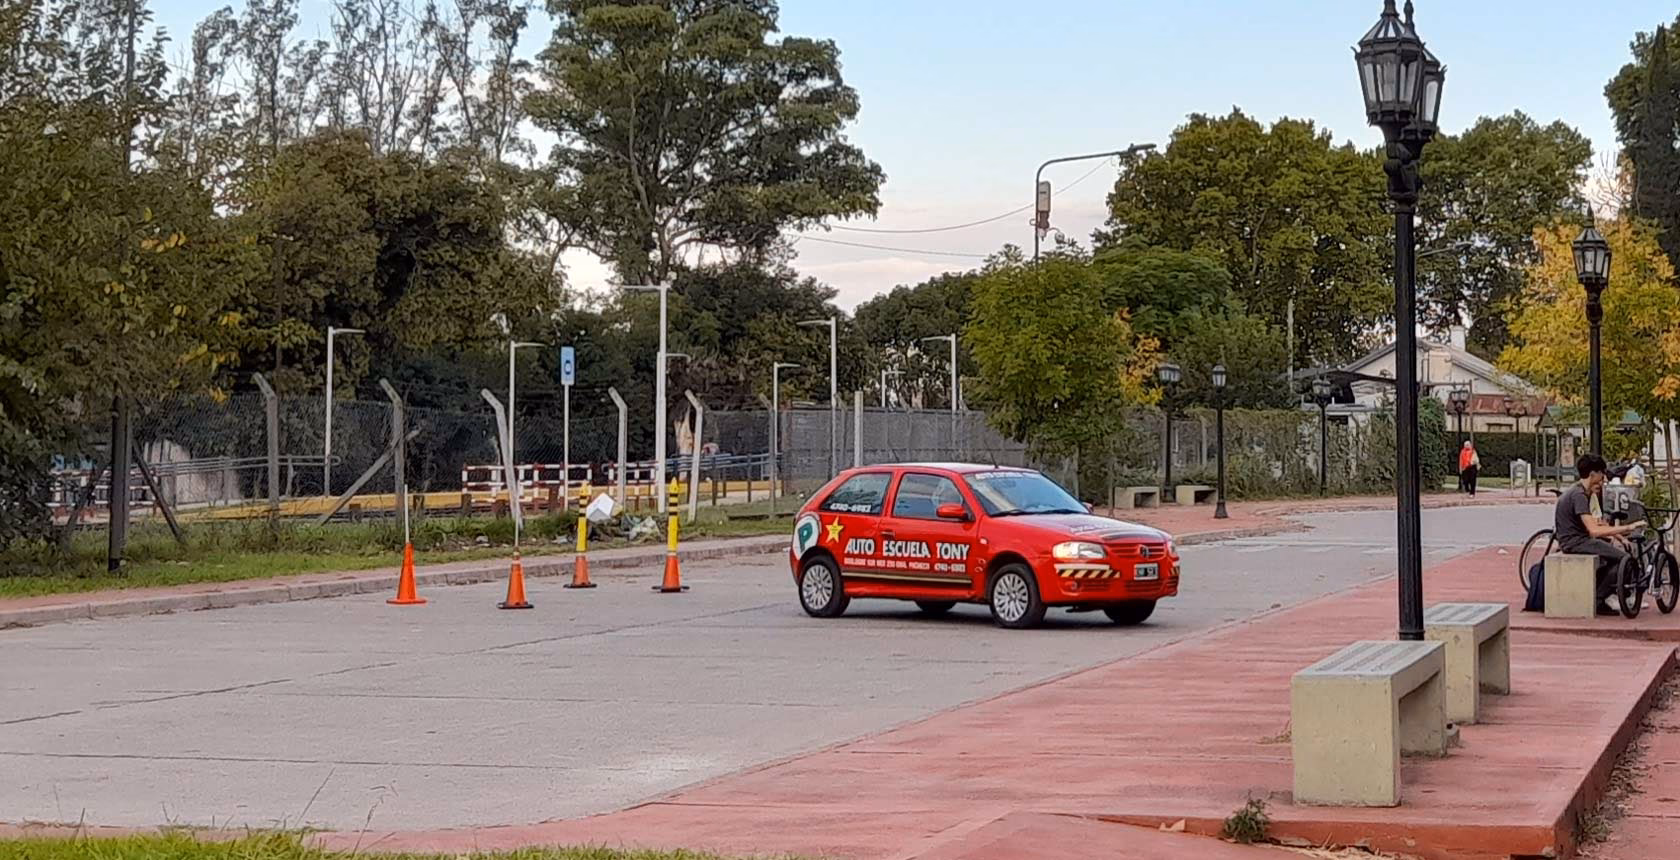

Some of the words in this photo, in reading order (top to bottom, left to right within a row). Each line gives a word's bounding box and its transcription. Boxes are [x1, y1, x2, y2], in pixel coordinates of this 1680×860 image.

[844, 538, 875, 555] AUTO
[882, 540, 931, 558] ESCUELA
[935, 542, 970, 561] TONY
